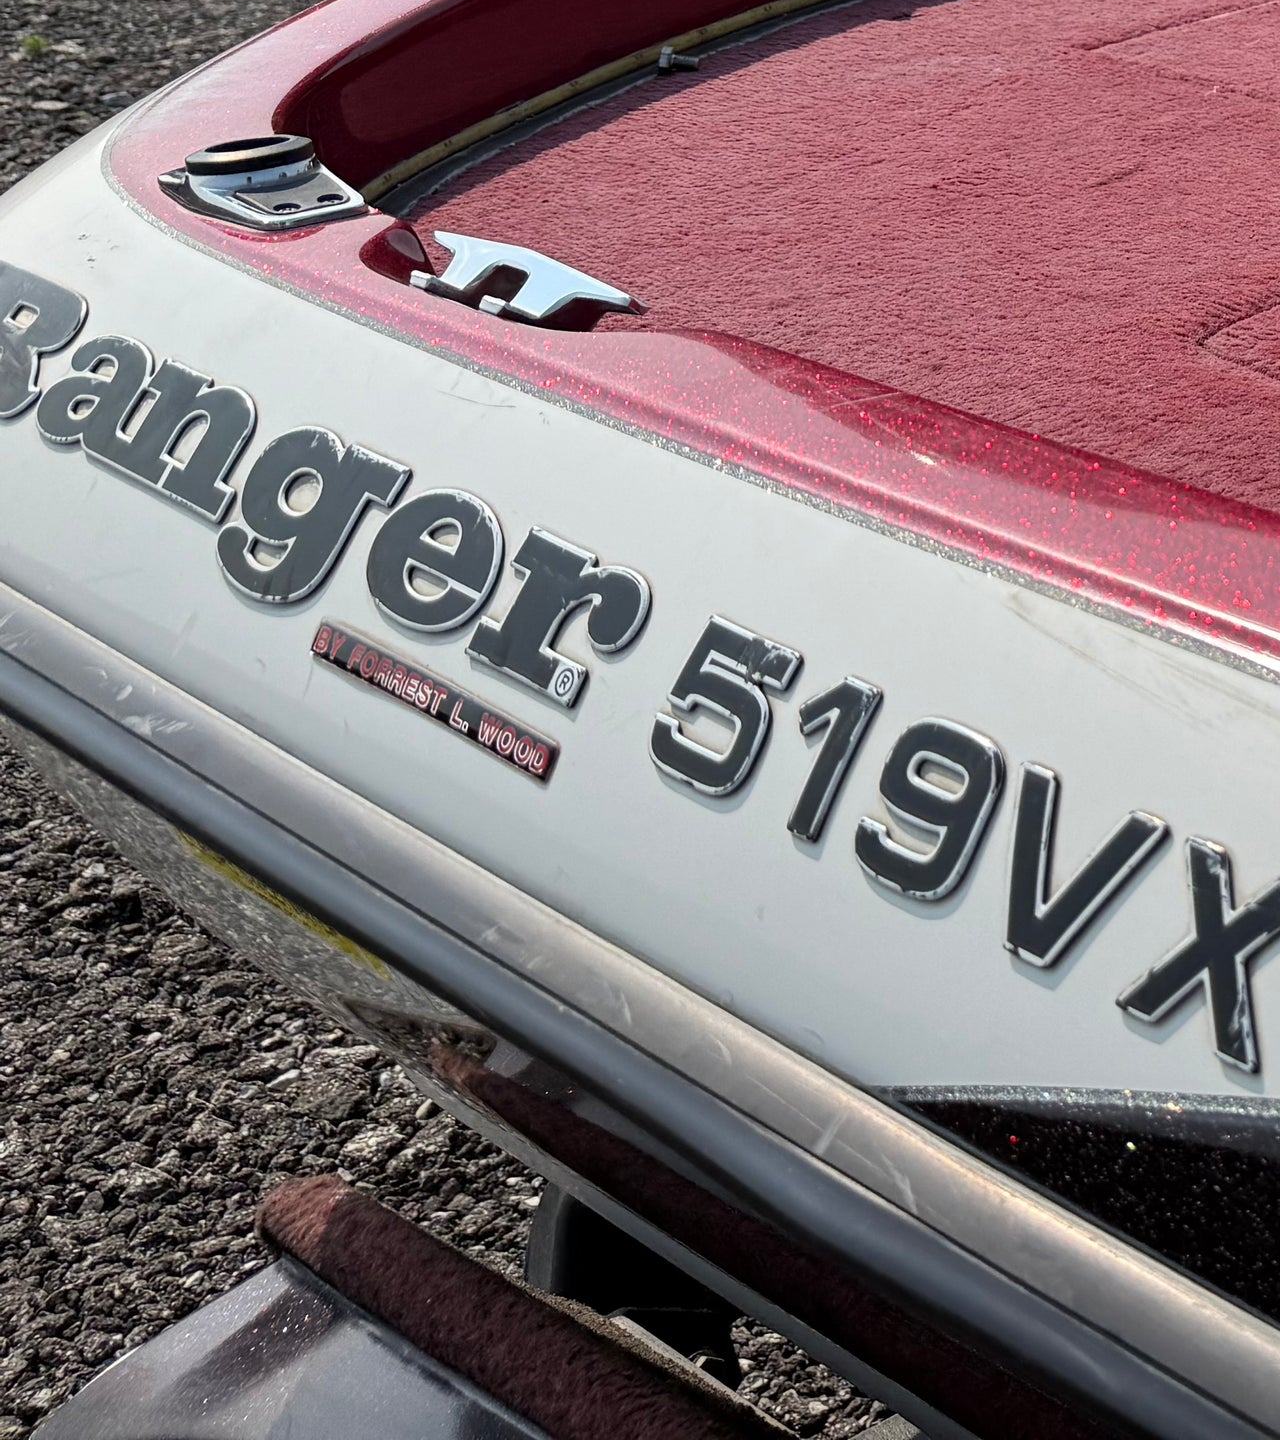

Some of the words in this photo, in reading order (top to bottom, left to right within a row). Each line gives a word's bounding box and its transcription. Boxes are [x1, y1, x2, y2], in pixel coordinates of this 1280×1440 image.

[313, 625, 347, 660] BY
[347, 645, 448, 716] FORREST
[449, 698, 469, 733] L.
[478, 711, 549, 774] WOOD
